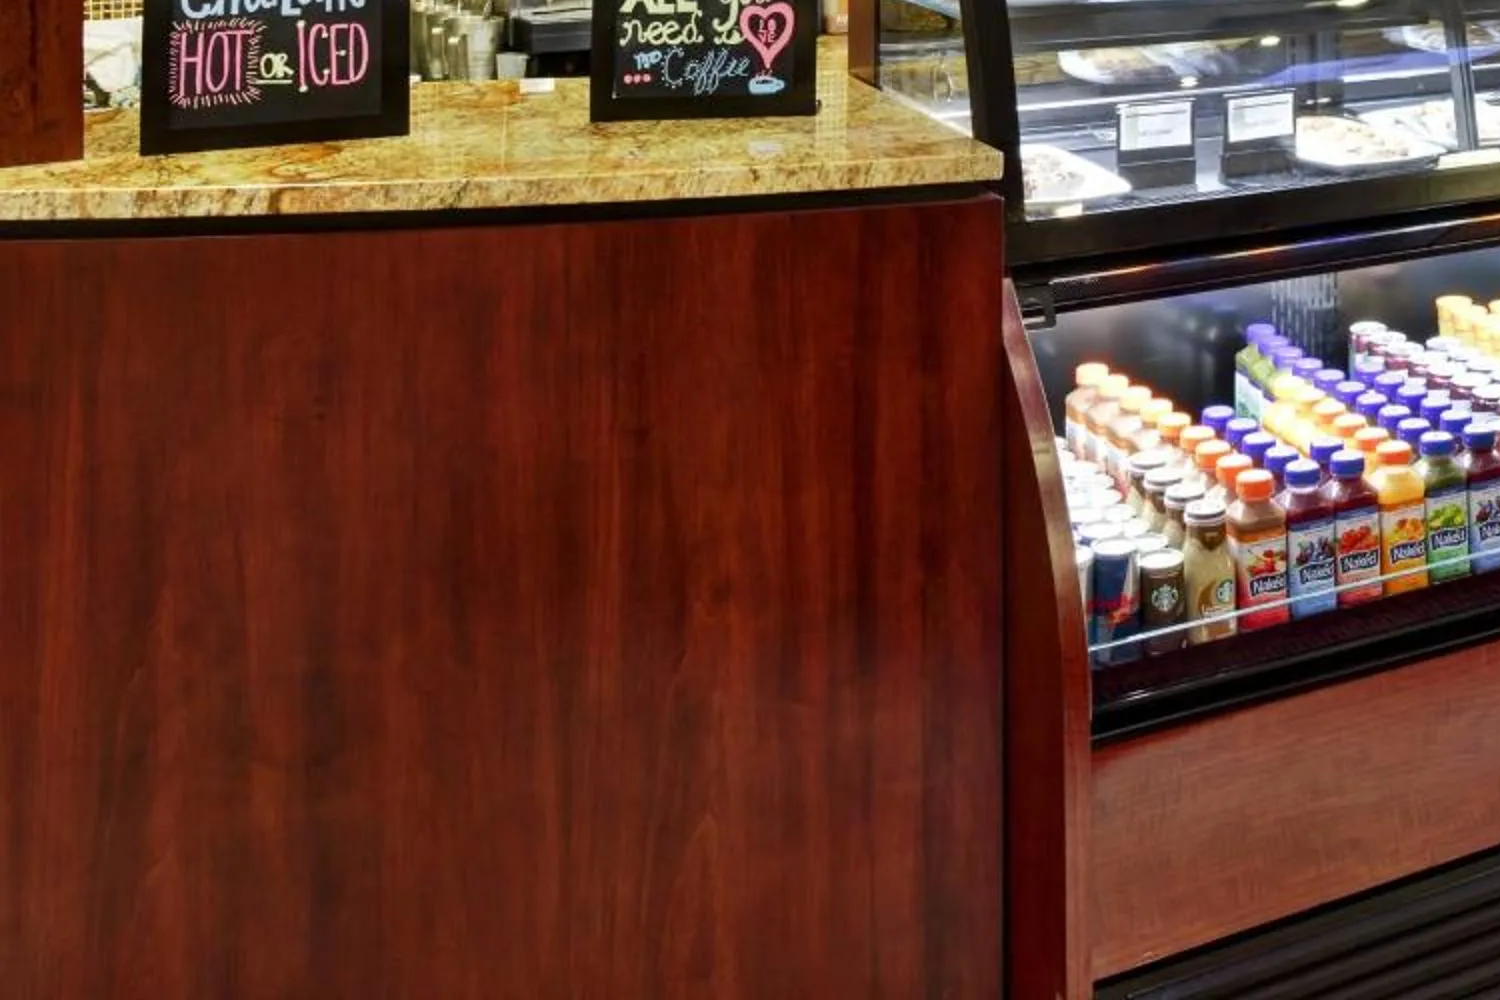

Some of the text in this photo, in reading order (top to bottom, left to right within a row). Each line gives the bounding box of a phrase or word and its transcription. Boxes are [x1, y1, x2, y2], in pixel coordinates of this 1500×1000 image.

[619, 10, 704, 48] need
[178, 19, 370, 99] HOT OR ICED
[660, 46, 752, 97] Coffee
[1433, 528, 1467, 550] Naked
[1341, 550, 1378, 573] Naked
